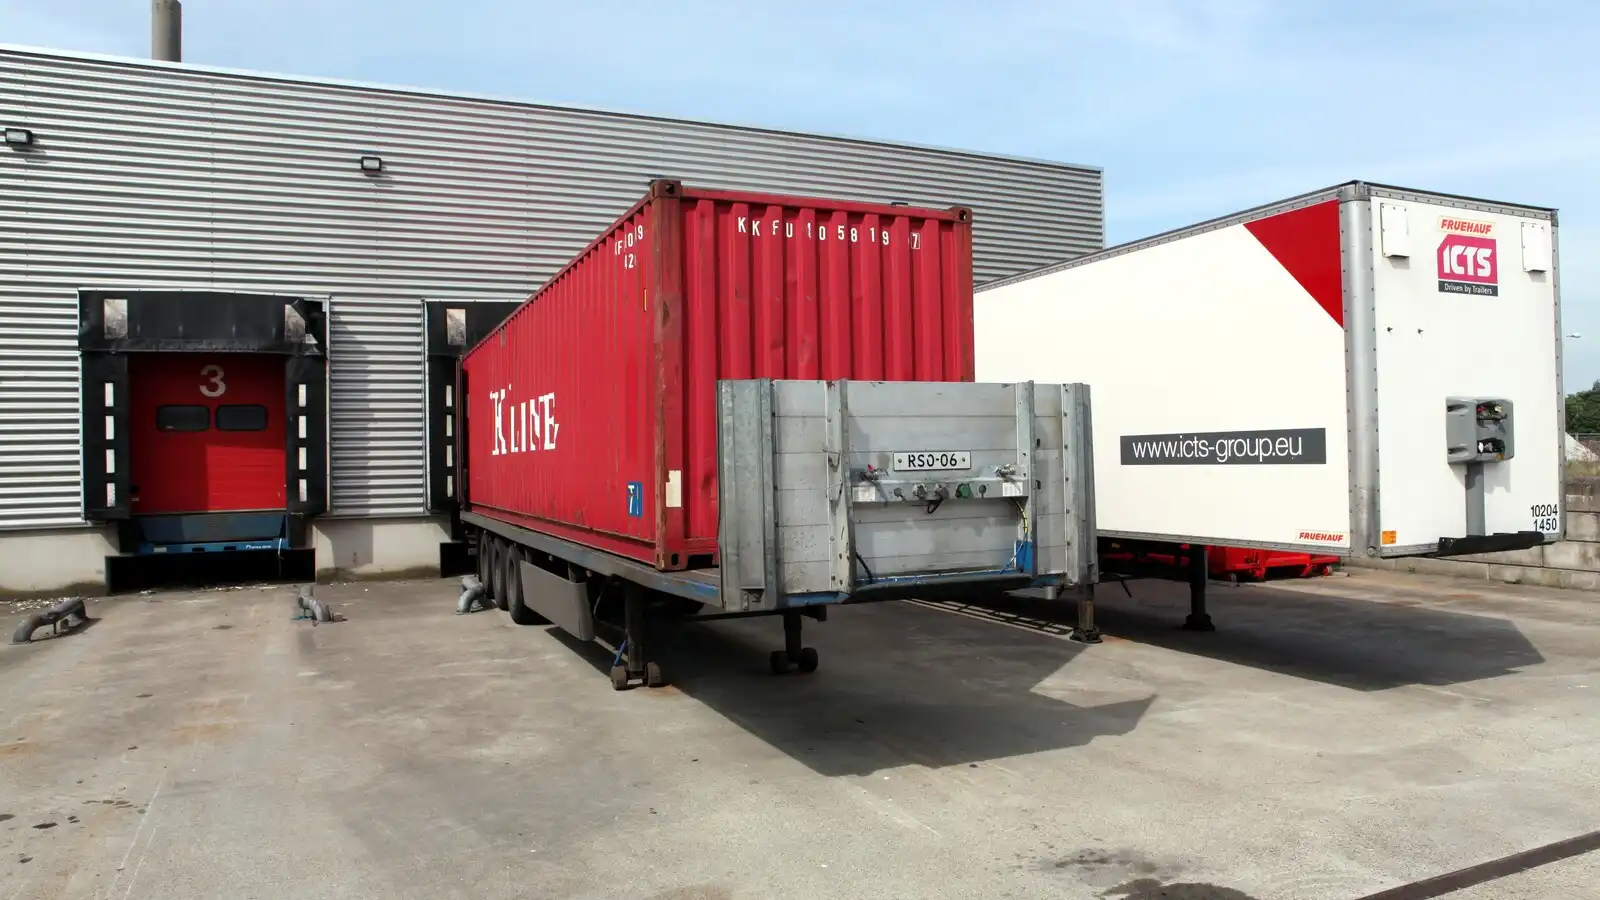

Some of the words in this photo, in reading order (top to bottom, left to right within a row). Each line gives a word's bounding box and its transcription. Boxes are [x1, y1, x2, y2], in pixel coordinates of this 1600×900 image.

[737, 217, 793, 238] KKFU
[1441, 219, 1492, 235] FRUEHAUF
[1443, 244, 1492, 278] ICTS
[1444, 283, 1463, 292] Driven
[1464, 284, 1472, 294] by
[1472, 285, 1493, 295] Trailers
[200, 365, 226, 397] 3
[1133, 435, 1302, 463] www.icts-group.eu
[1531, 504, 1558, 517] 10204
[1534, 518, 1557, 532] 1450
[1299, 532, 1344, 542] FRUEHAUF
